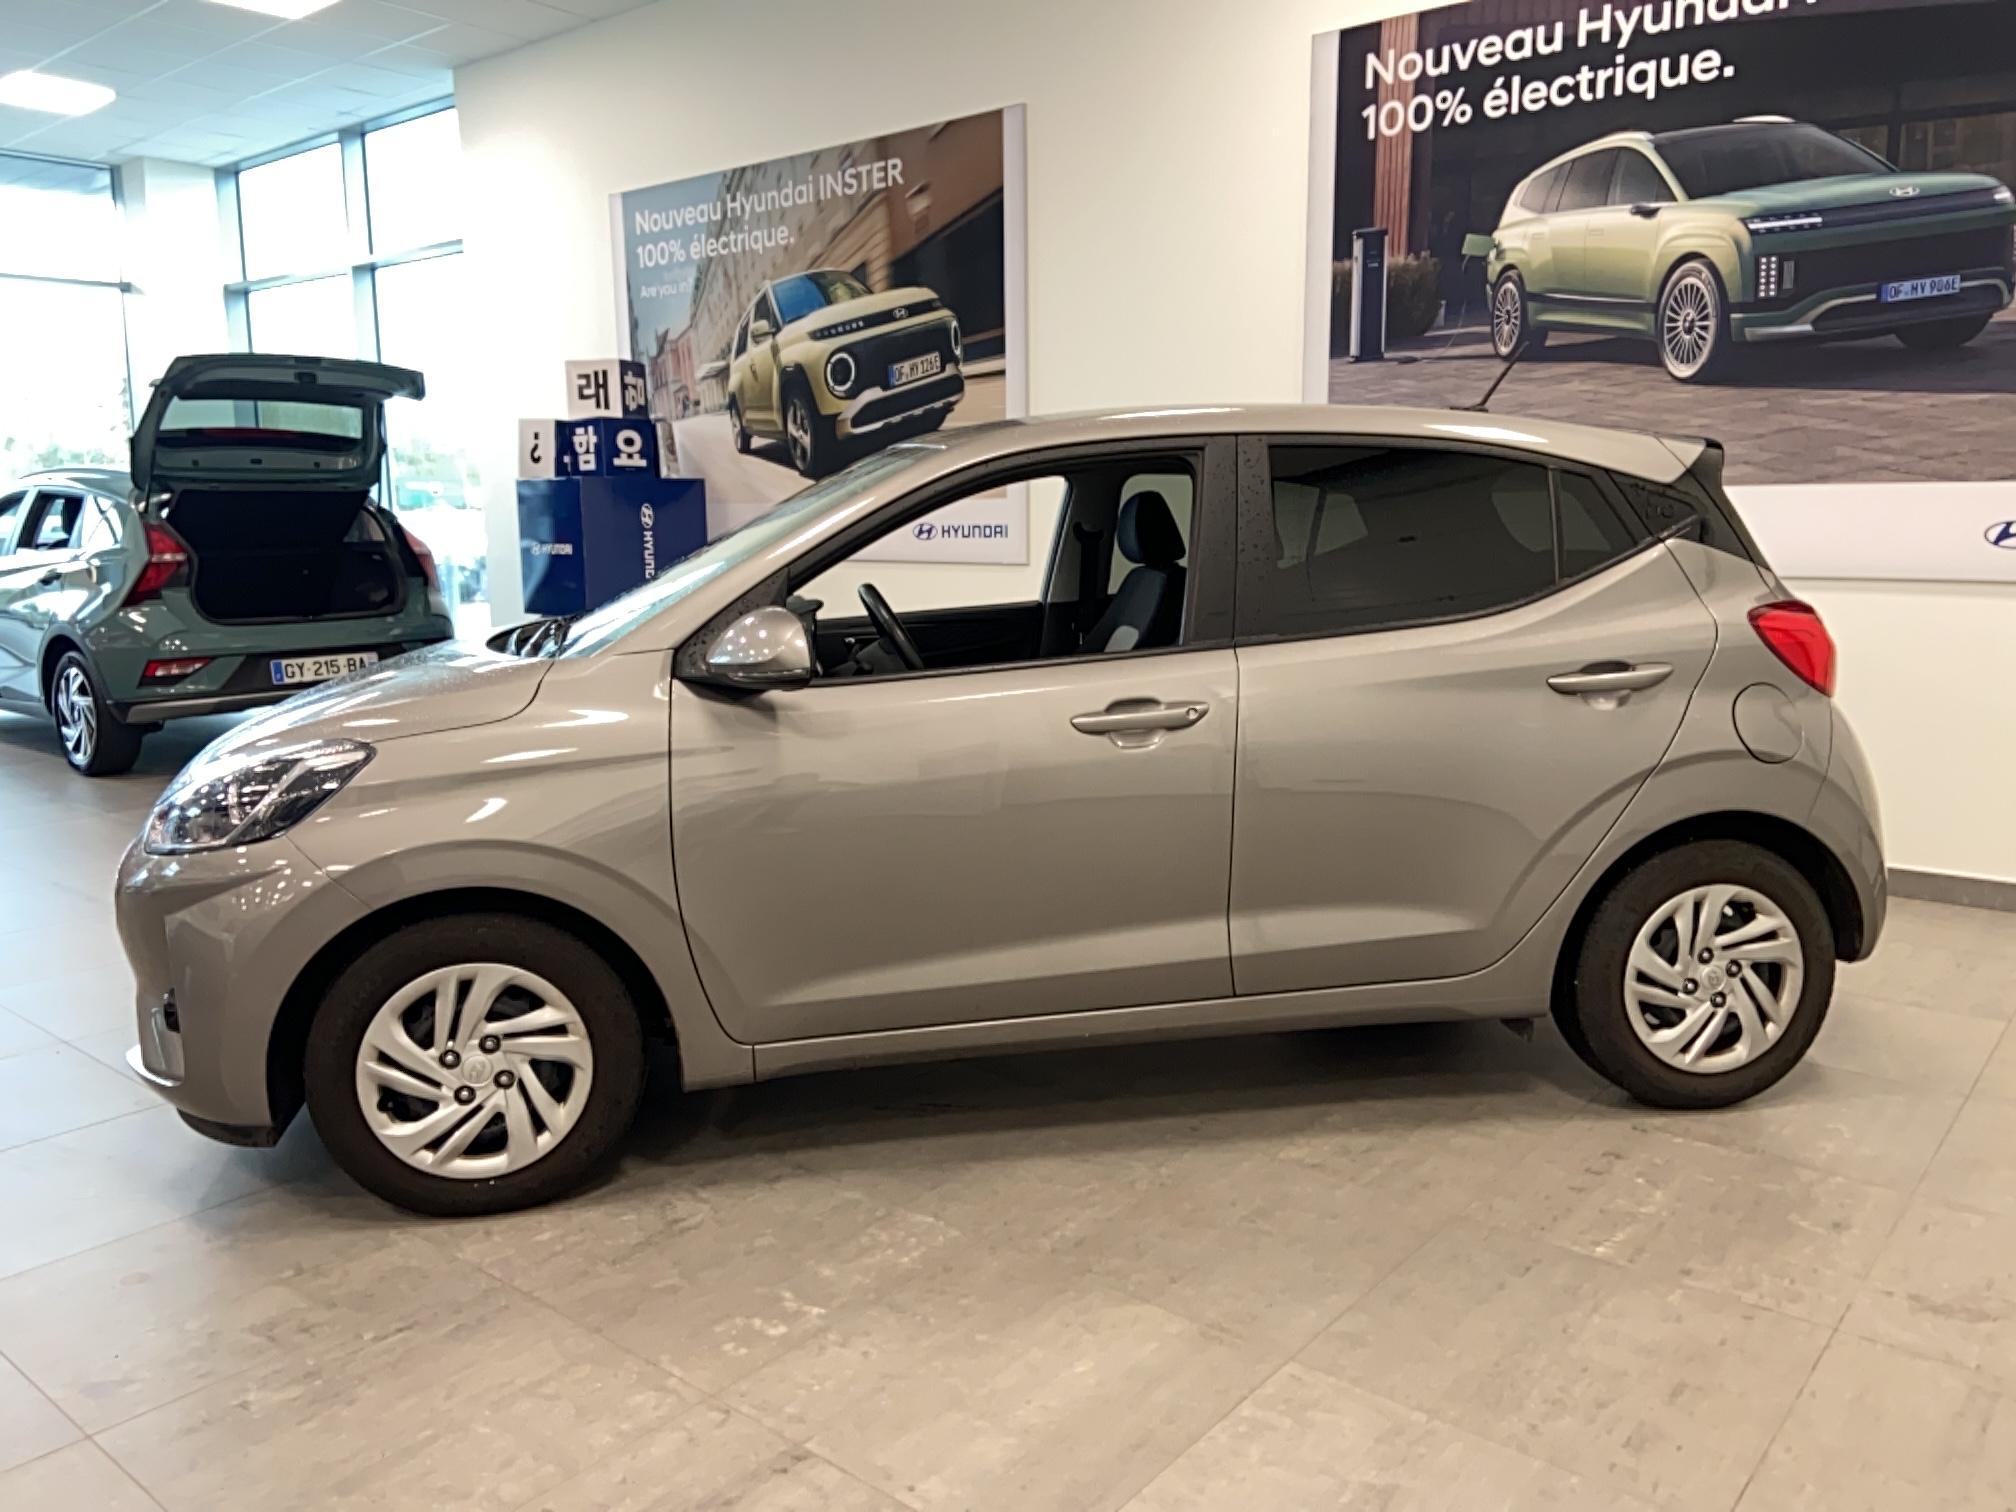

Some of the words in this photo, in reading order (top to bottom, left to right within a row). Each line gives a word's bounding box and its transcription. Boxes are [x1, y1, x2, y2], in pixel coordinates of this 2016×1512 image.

[1365, 21, 1563, 89] Nouveau
[1577, 0, 1790, 49] Hyunda
[1361, 86, 1473, 140] 100%
[1483, 49, 1735, 119] électrique.
[635, 204, 721, 236] Nouveau
[726, 175, 813, 220] Hyundai
[819, 158, 904, 199] INSTER
[636, 239, 685, 269] 100%
[690, 225, 795, 260] électrique.
[640, 285, 657, 299] Are
[657, 283, 677, 299] you
[577, 369, 610, 410] 래
[572, 425, 597, 471] 함
[612, 429, 647, 467] 요
[941, 525, 1008, 538] HYUNDAI
